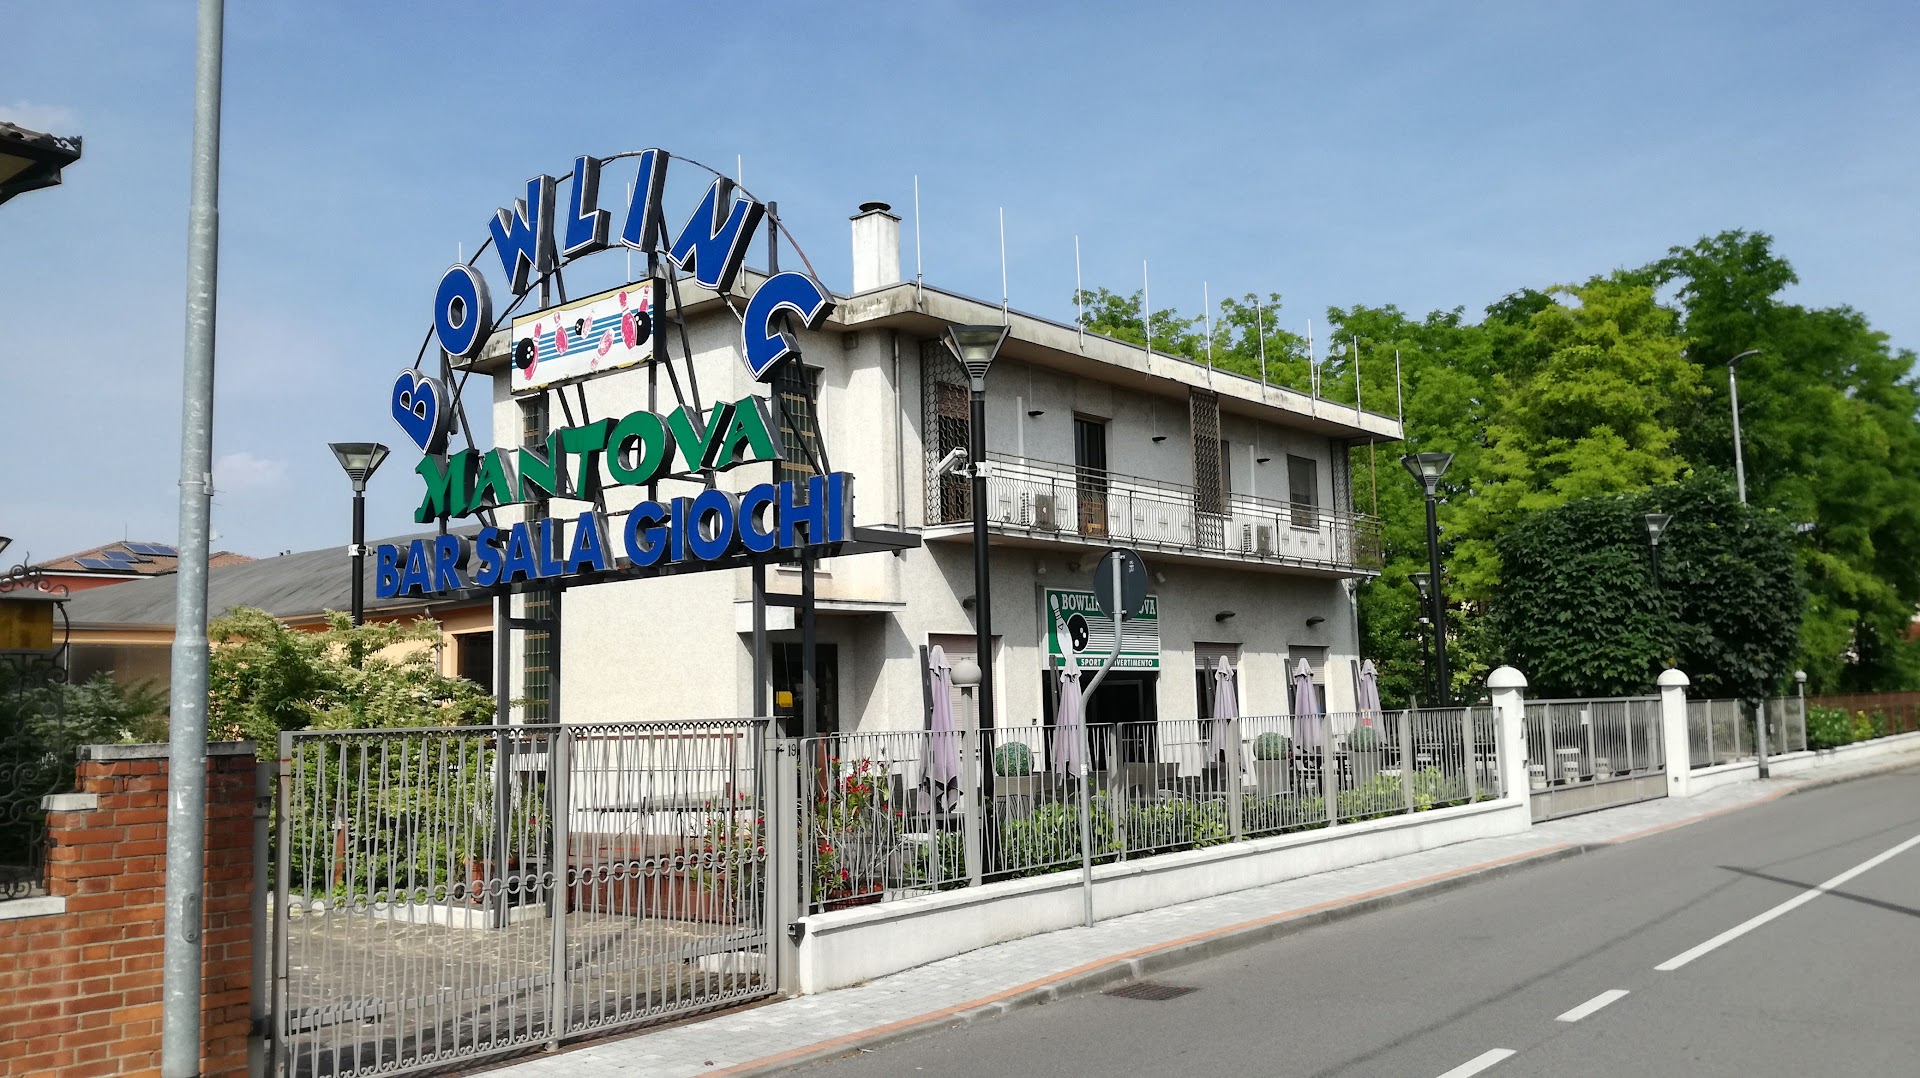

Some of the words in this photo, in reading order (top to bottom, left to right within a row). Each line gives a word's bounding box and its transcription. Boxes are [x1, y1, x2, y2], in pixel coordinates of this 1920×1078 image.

[391, 149, 832, 454] BOWLING
[415, 394, 784, 523] MANTOVA
[376, 532, 466, 599] BAR
[476, 511, 609, 588] SALA
[624, 471, 848, 567] GIOCHI
[1061, 593, 1100, 612] BOWLI
[1080, 658, 1102, 666] SPORT
[1113, 659, 1153, 667] IVERTIMENTO
[787, 743, 796, 757] 19
